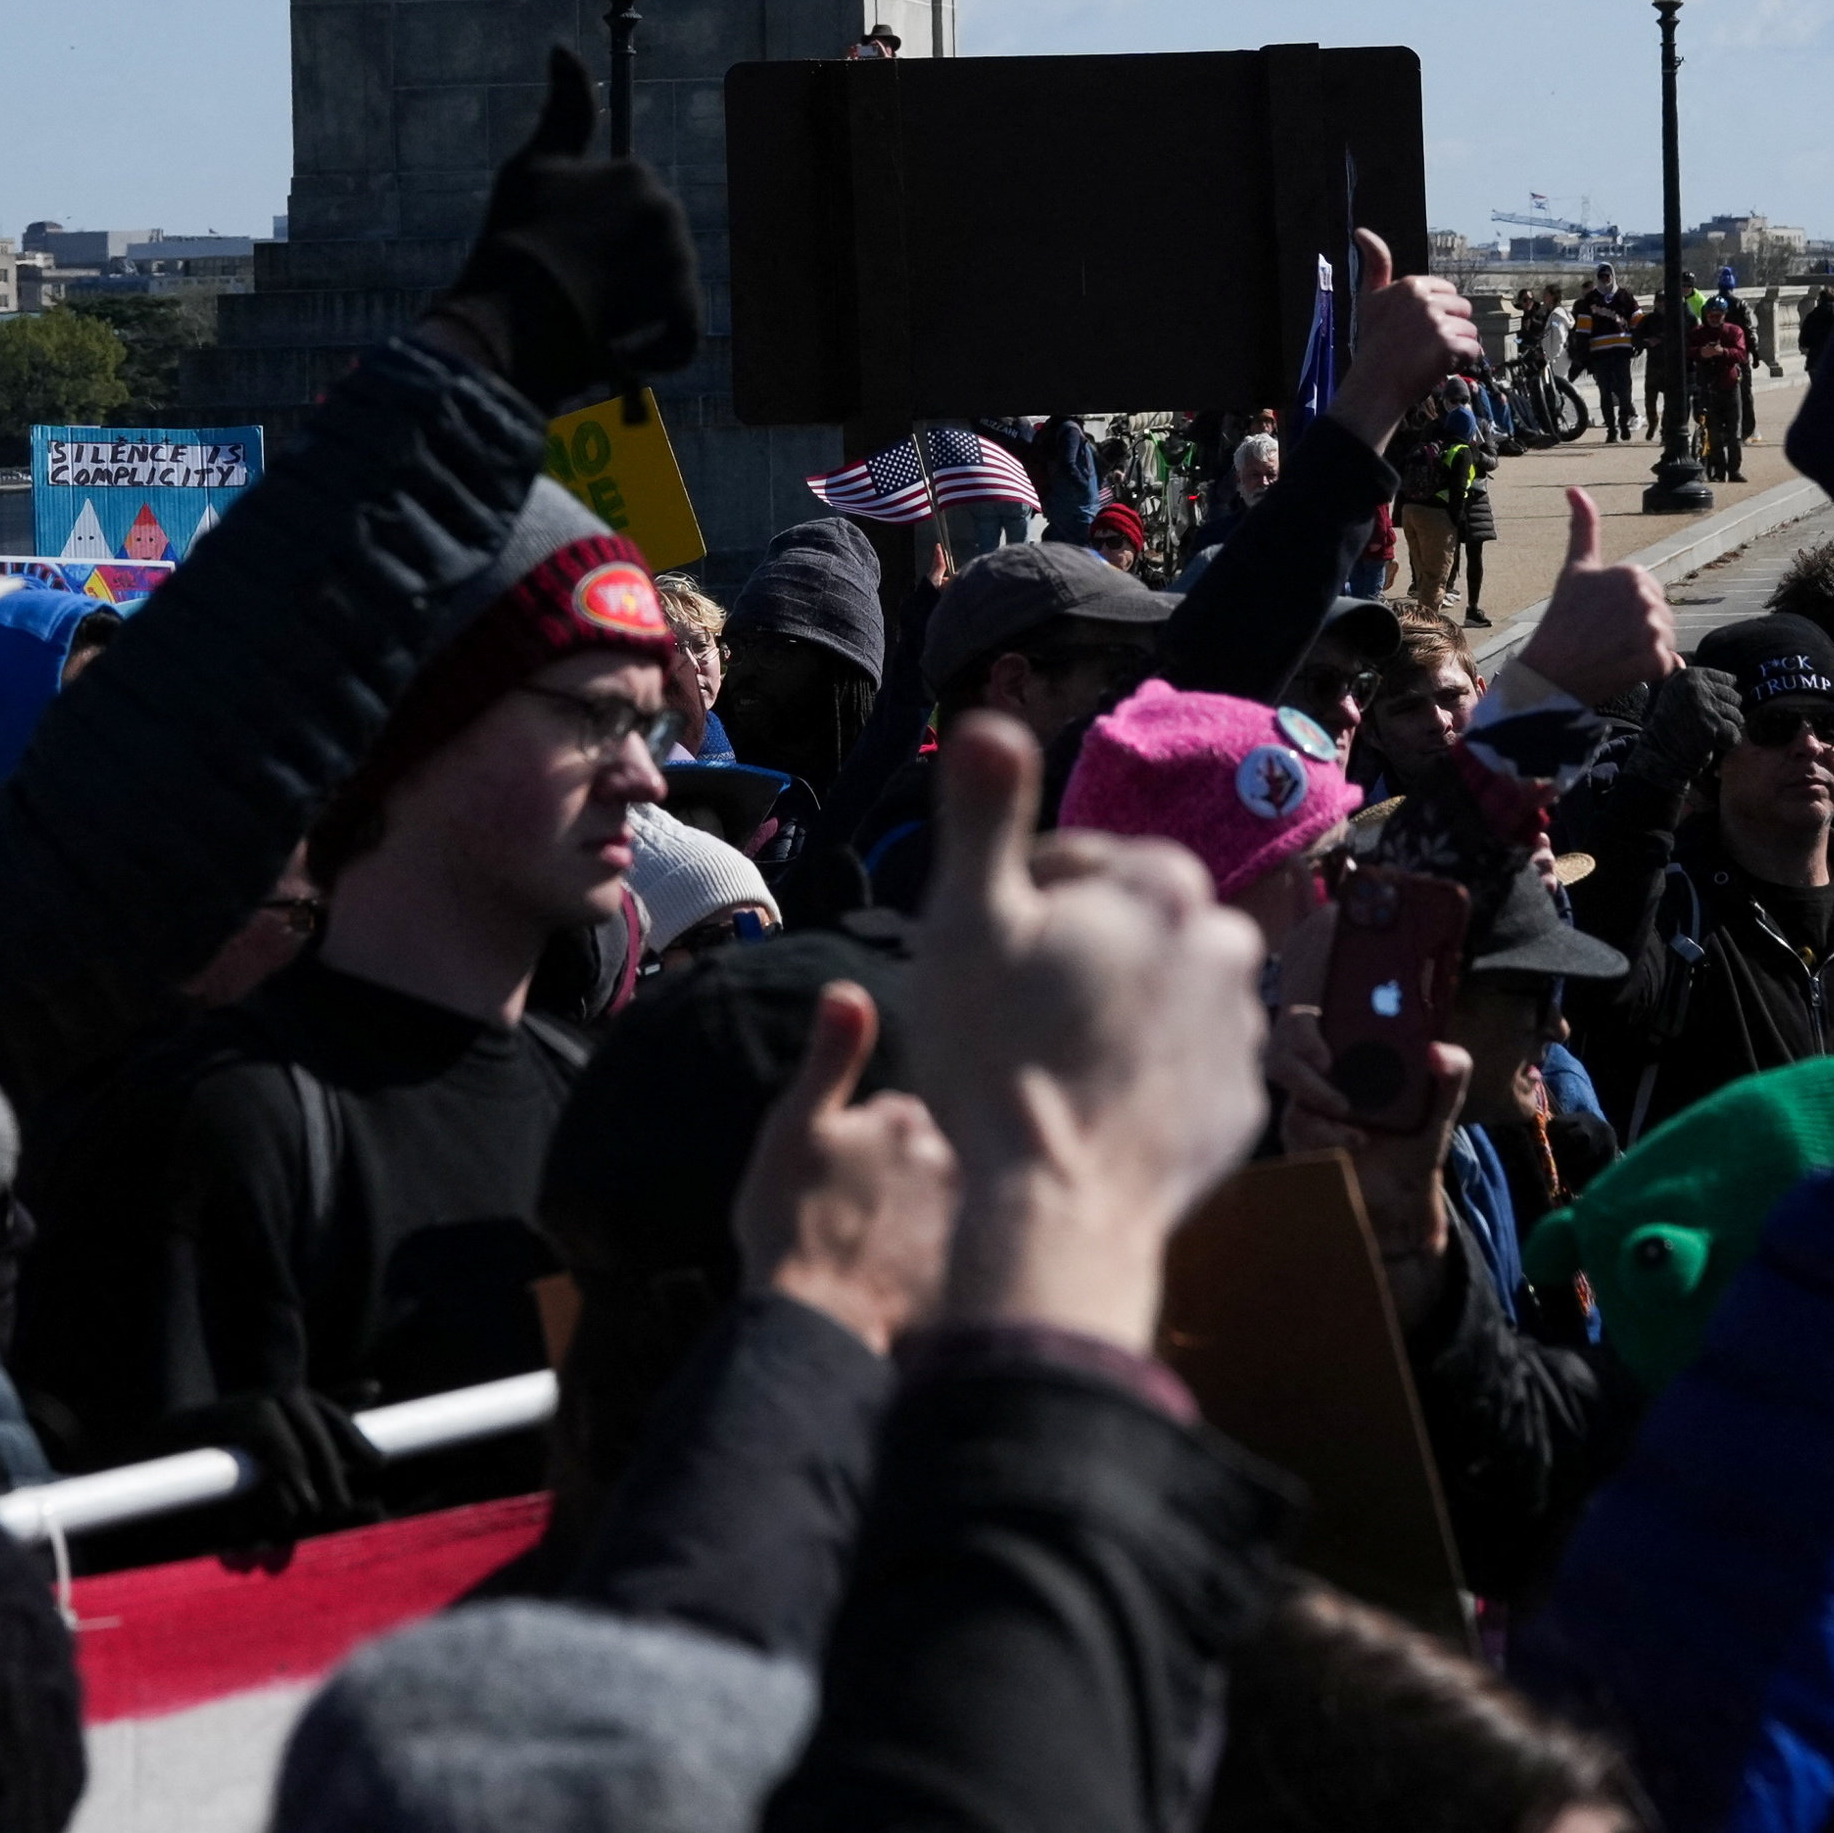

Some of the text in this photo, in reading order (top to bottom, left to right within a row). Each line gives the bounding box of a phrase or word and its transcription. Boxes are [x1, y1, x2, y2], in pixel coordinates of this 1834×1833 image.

[51, 441, 242, 464] SILENCE IS
[51, 465, 236, 487] COMPLICITY
[1751, 673, 1832, 701] TRUMP
